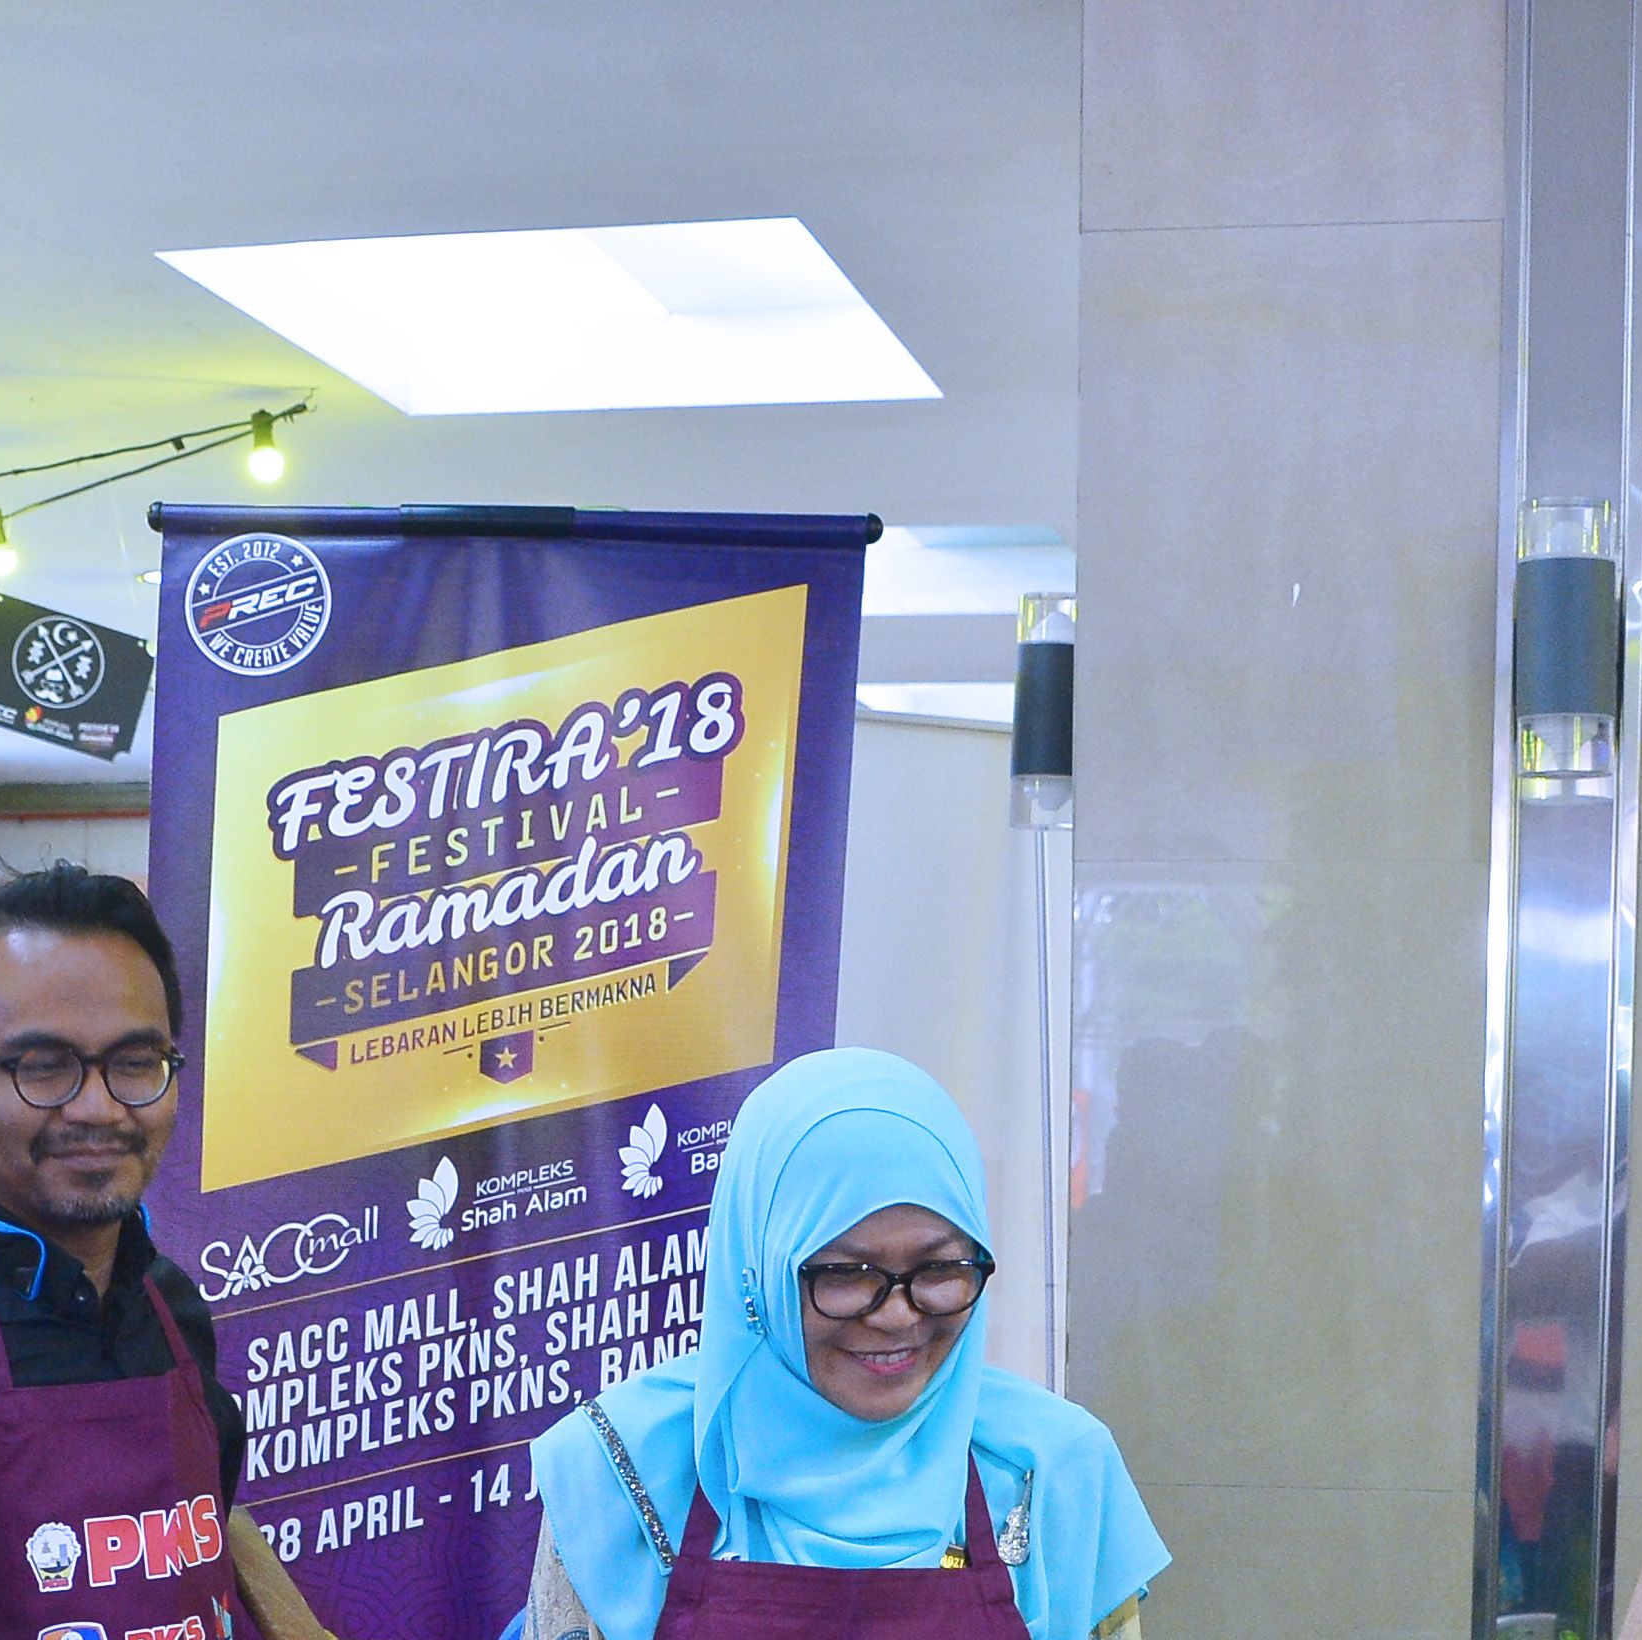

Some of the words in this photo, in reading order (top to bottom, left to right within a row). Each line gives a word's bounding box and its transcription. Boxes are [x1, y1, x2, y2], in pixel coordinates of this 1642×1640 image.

[199, 575, 318, 629] PREC
[207, 549, 239, 578] EST.
[242, 541, 282, 560] 2012
[208, 632, 234, 660] WE
[233, 642, 292, 667] CREATE
[287, 603, 323, 650] VALUE
[276, 679, 738, 852] FESTIRA'18
[370, 802, 644, 884] FESTIVAL
[320, 833, 697, 968] Ramadan
[343, 934, 554, 1014] SELANGOR
[573, 910, 668, 958] 2018
[349, 1020, 457, 1065] LEBARAN
[461, 1001, 534, 1038] LEBIH
[539, 972, 658, 1020] BERMAKNA
[461, 1199, 517, 1232] Shah
[525, 1185, 588, 1216] Alam
[476, 1159, 574, 1197] KOMPLEKS
[246, 1316, 348, 1383] SACC
[364, 1290, 478, 1355] MALL,
[493, 1253, 599, 1320] SHAH
[418, 1322, 529, 1389] PKNS,
[545, 1290, 650, 1356] SHAH
[246, 1389, 457, 1482] KOMPLEKS
[469, 1358, 583, 1426] PKNS,
[315, 1493, 425, 1555] APRIL
[469, 1463, 512, 1511] 14
